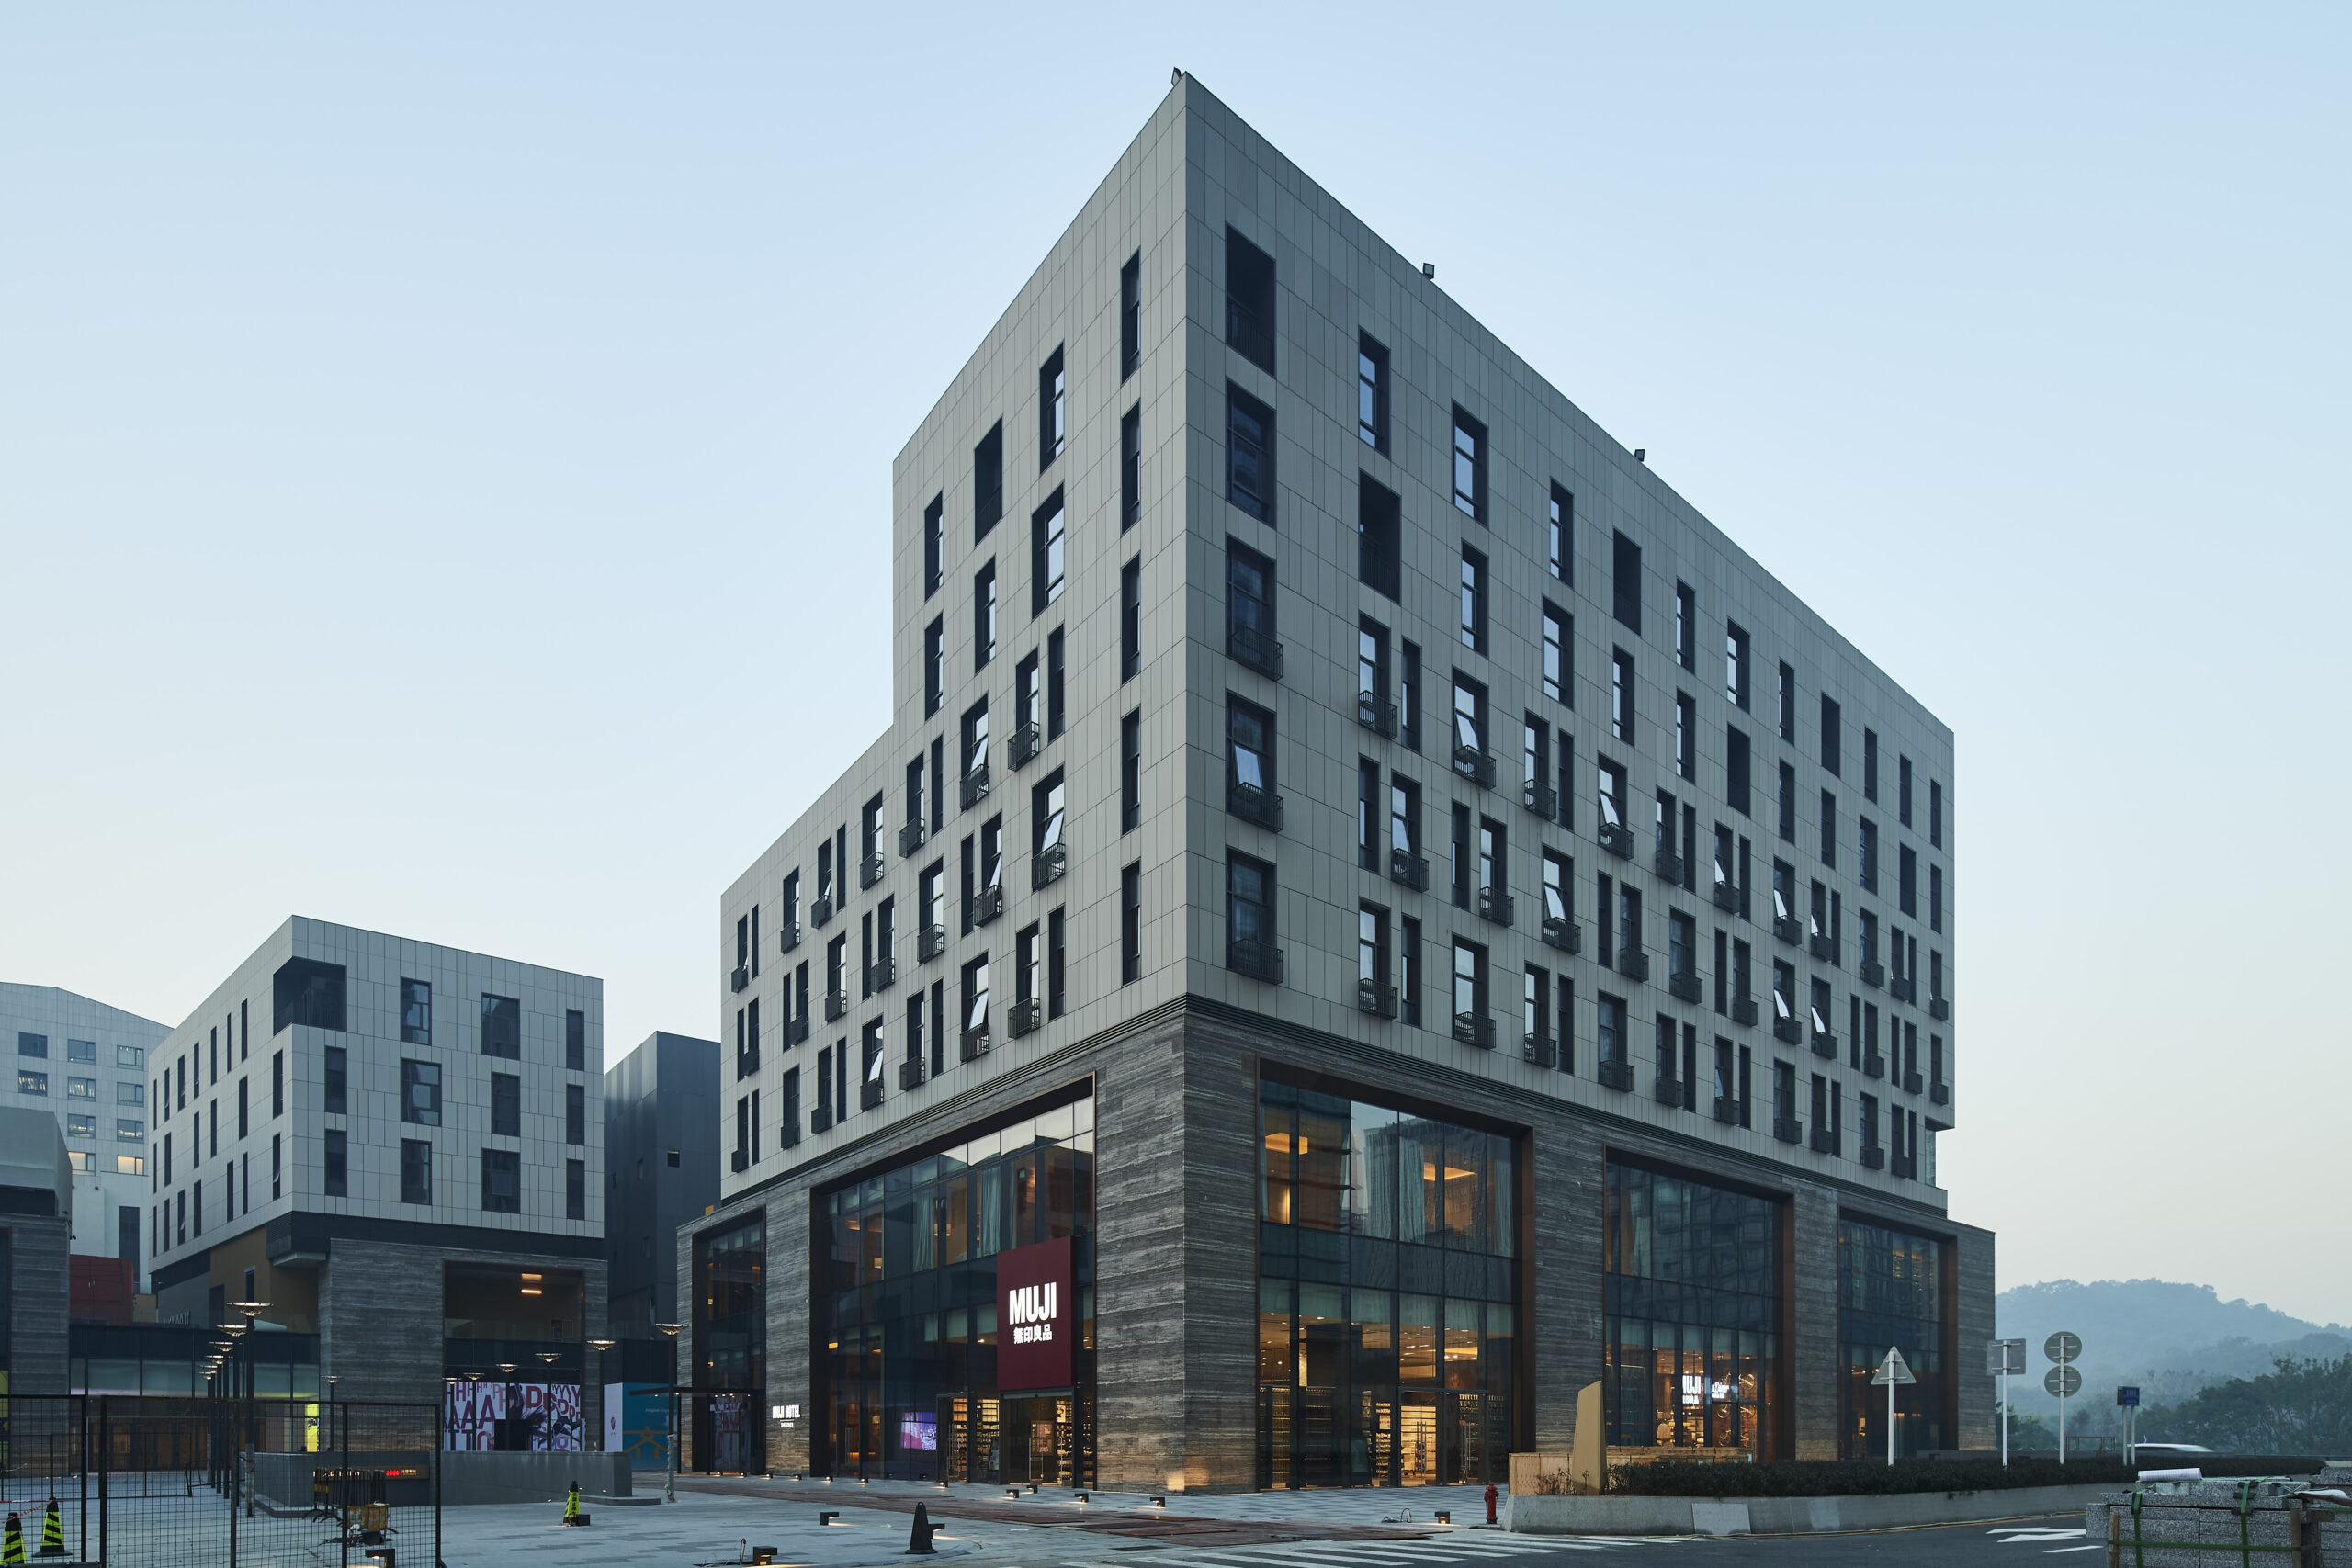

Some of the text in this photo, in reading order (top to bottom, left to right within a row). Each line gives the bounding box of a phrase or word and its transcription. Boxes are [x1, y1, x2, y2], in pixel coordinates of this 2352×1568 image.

[1009, 1282, 1057, 1325] MUJI
[1013, 1324, 1053, 1345] 無印良品
[772, 1404, 801, 1419] MUJI HOTEL
